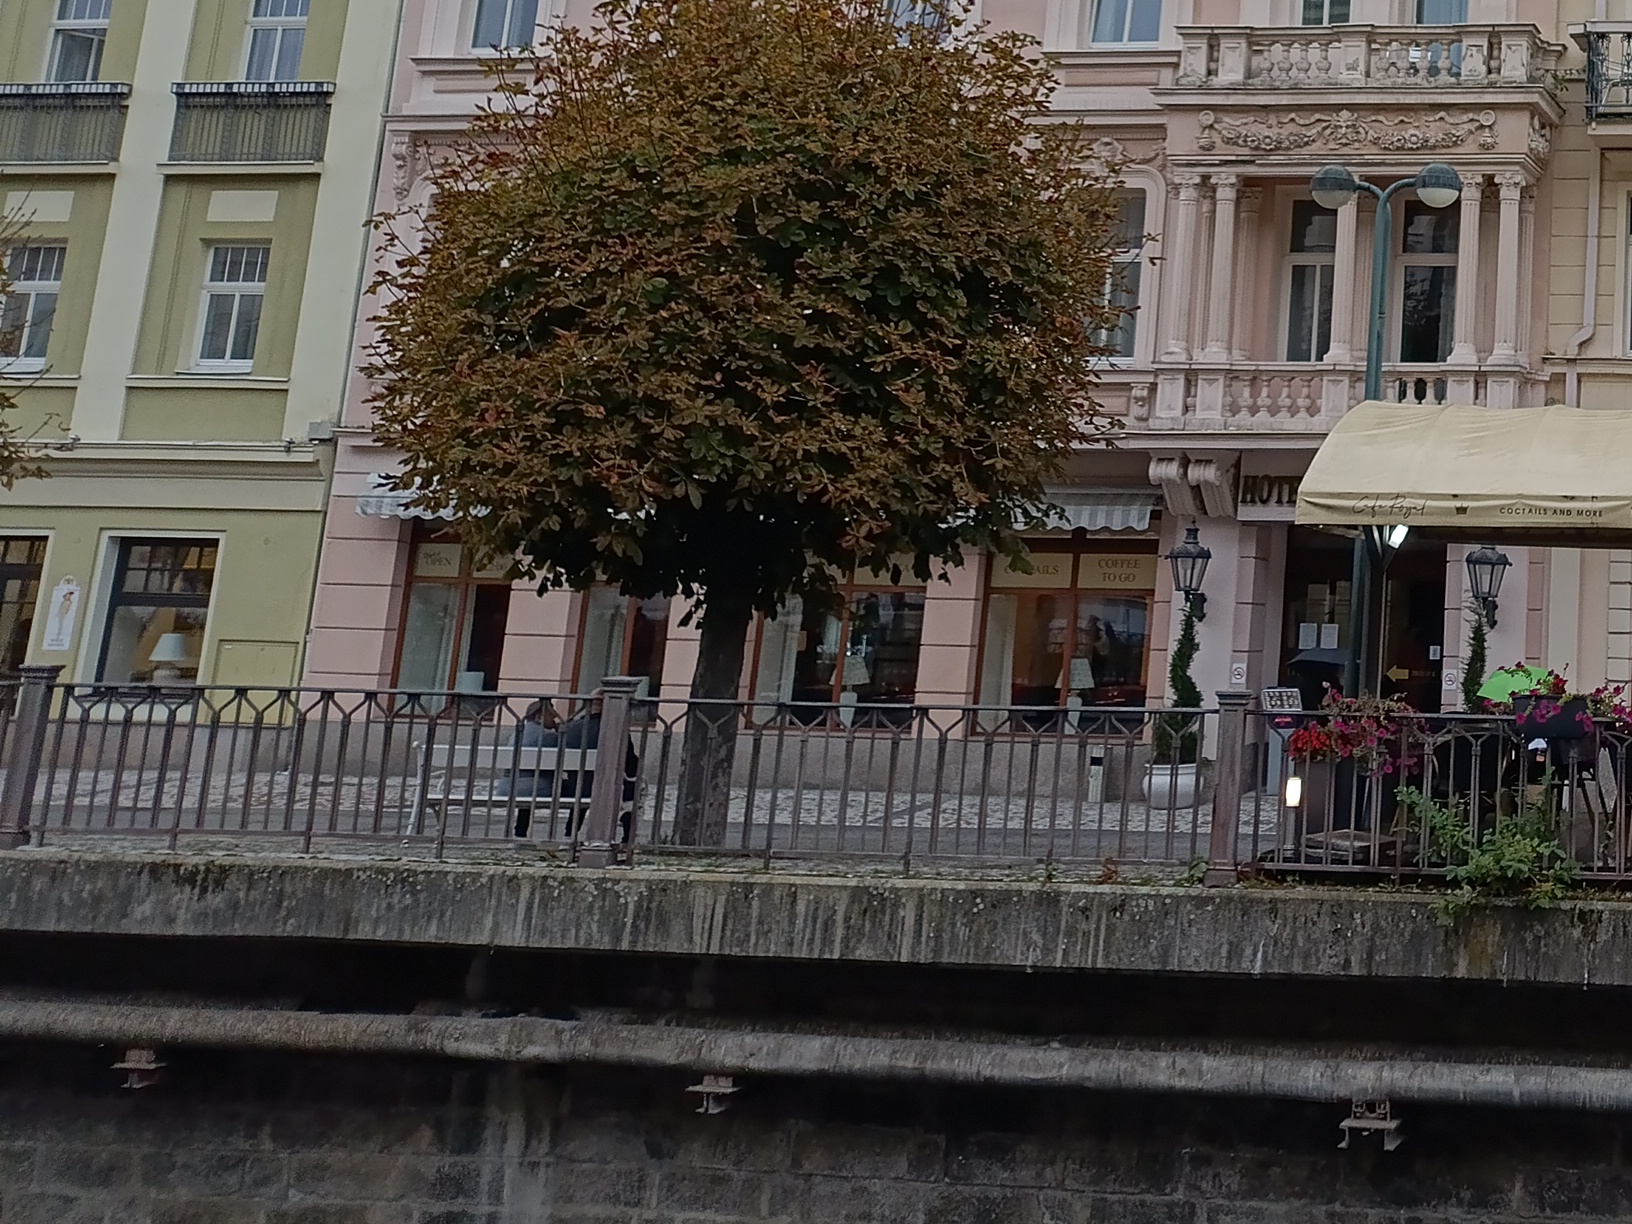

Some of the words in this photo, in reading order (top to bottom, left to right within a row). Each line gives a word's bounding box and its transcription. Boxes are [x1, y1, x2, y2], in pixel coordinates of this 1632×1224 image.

[1240, 474, 1303, 504] HOTE
[1388, 492, 1428, 519] Royal
[1499, 507, 1548, 516] COCTAILS
[1551, 508, 1572, 517] AND
[1576, 509, 1603, 518] MORE
[1098, 558, 1141, 569] COFFEE
[1102, 572, 1117, 582] TO
[1118, 573, 1136, 582] GO
